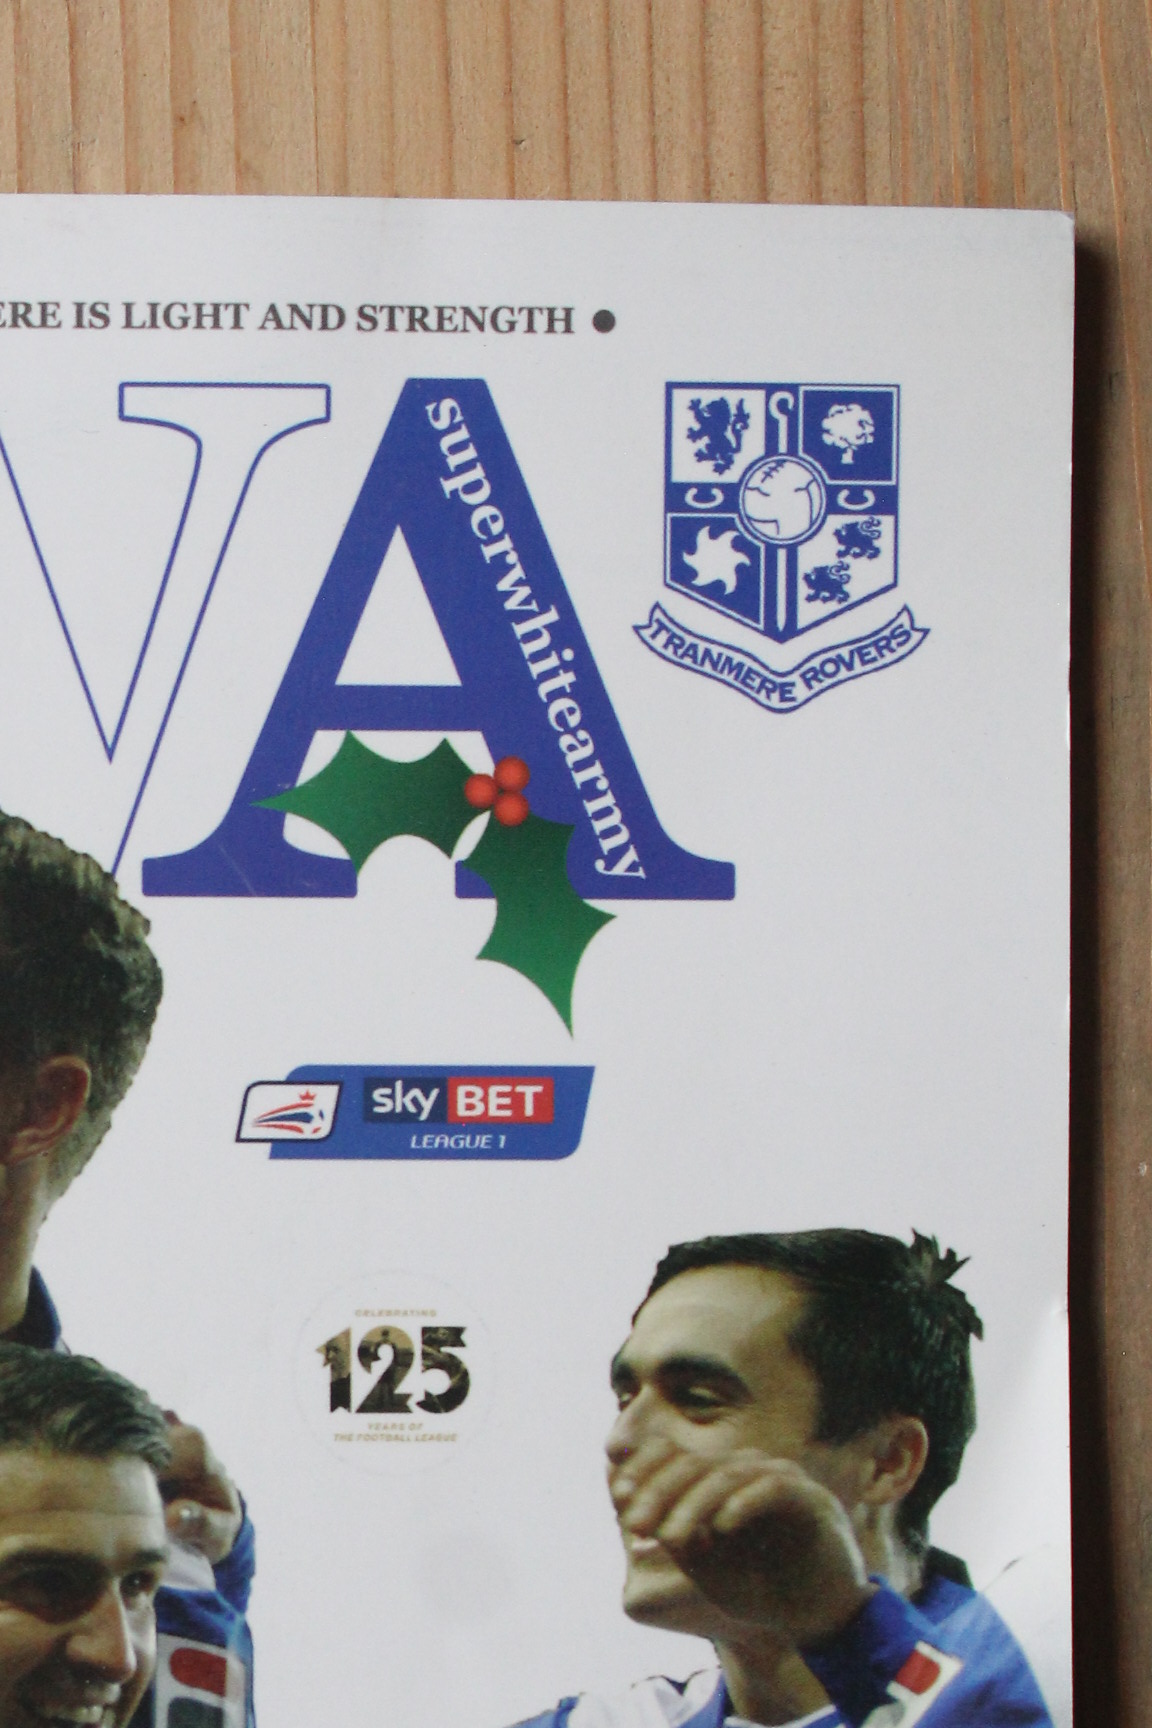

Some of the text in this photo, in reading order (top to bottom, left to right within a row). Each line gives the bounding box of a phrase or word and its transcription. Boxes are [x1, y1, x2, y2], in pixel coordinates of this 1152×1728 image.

[73, 301, 111, 330] IS
[121, 301, 251, 332] LIGHT
[258, 303, 346, 332] AND
[356, 304, 575, 335] STRENGTH
[424, 396, 648, 882] superwhitearmy
[649, 619, 913, 702] TRANMERE ROVERS
[371, 1079, 544, 1122] sky BET
[409, 1135, 507, 1150] LEAGUE 1
[315, 1324, 472, 1415] 125
